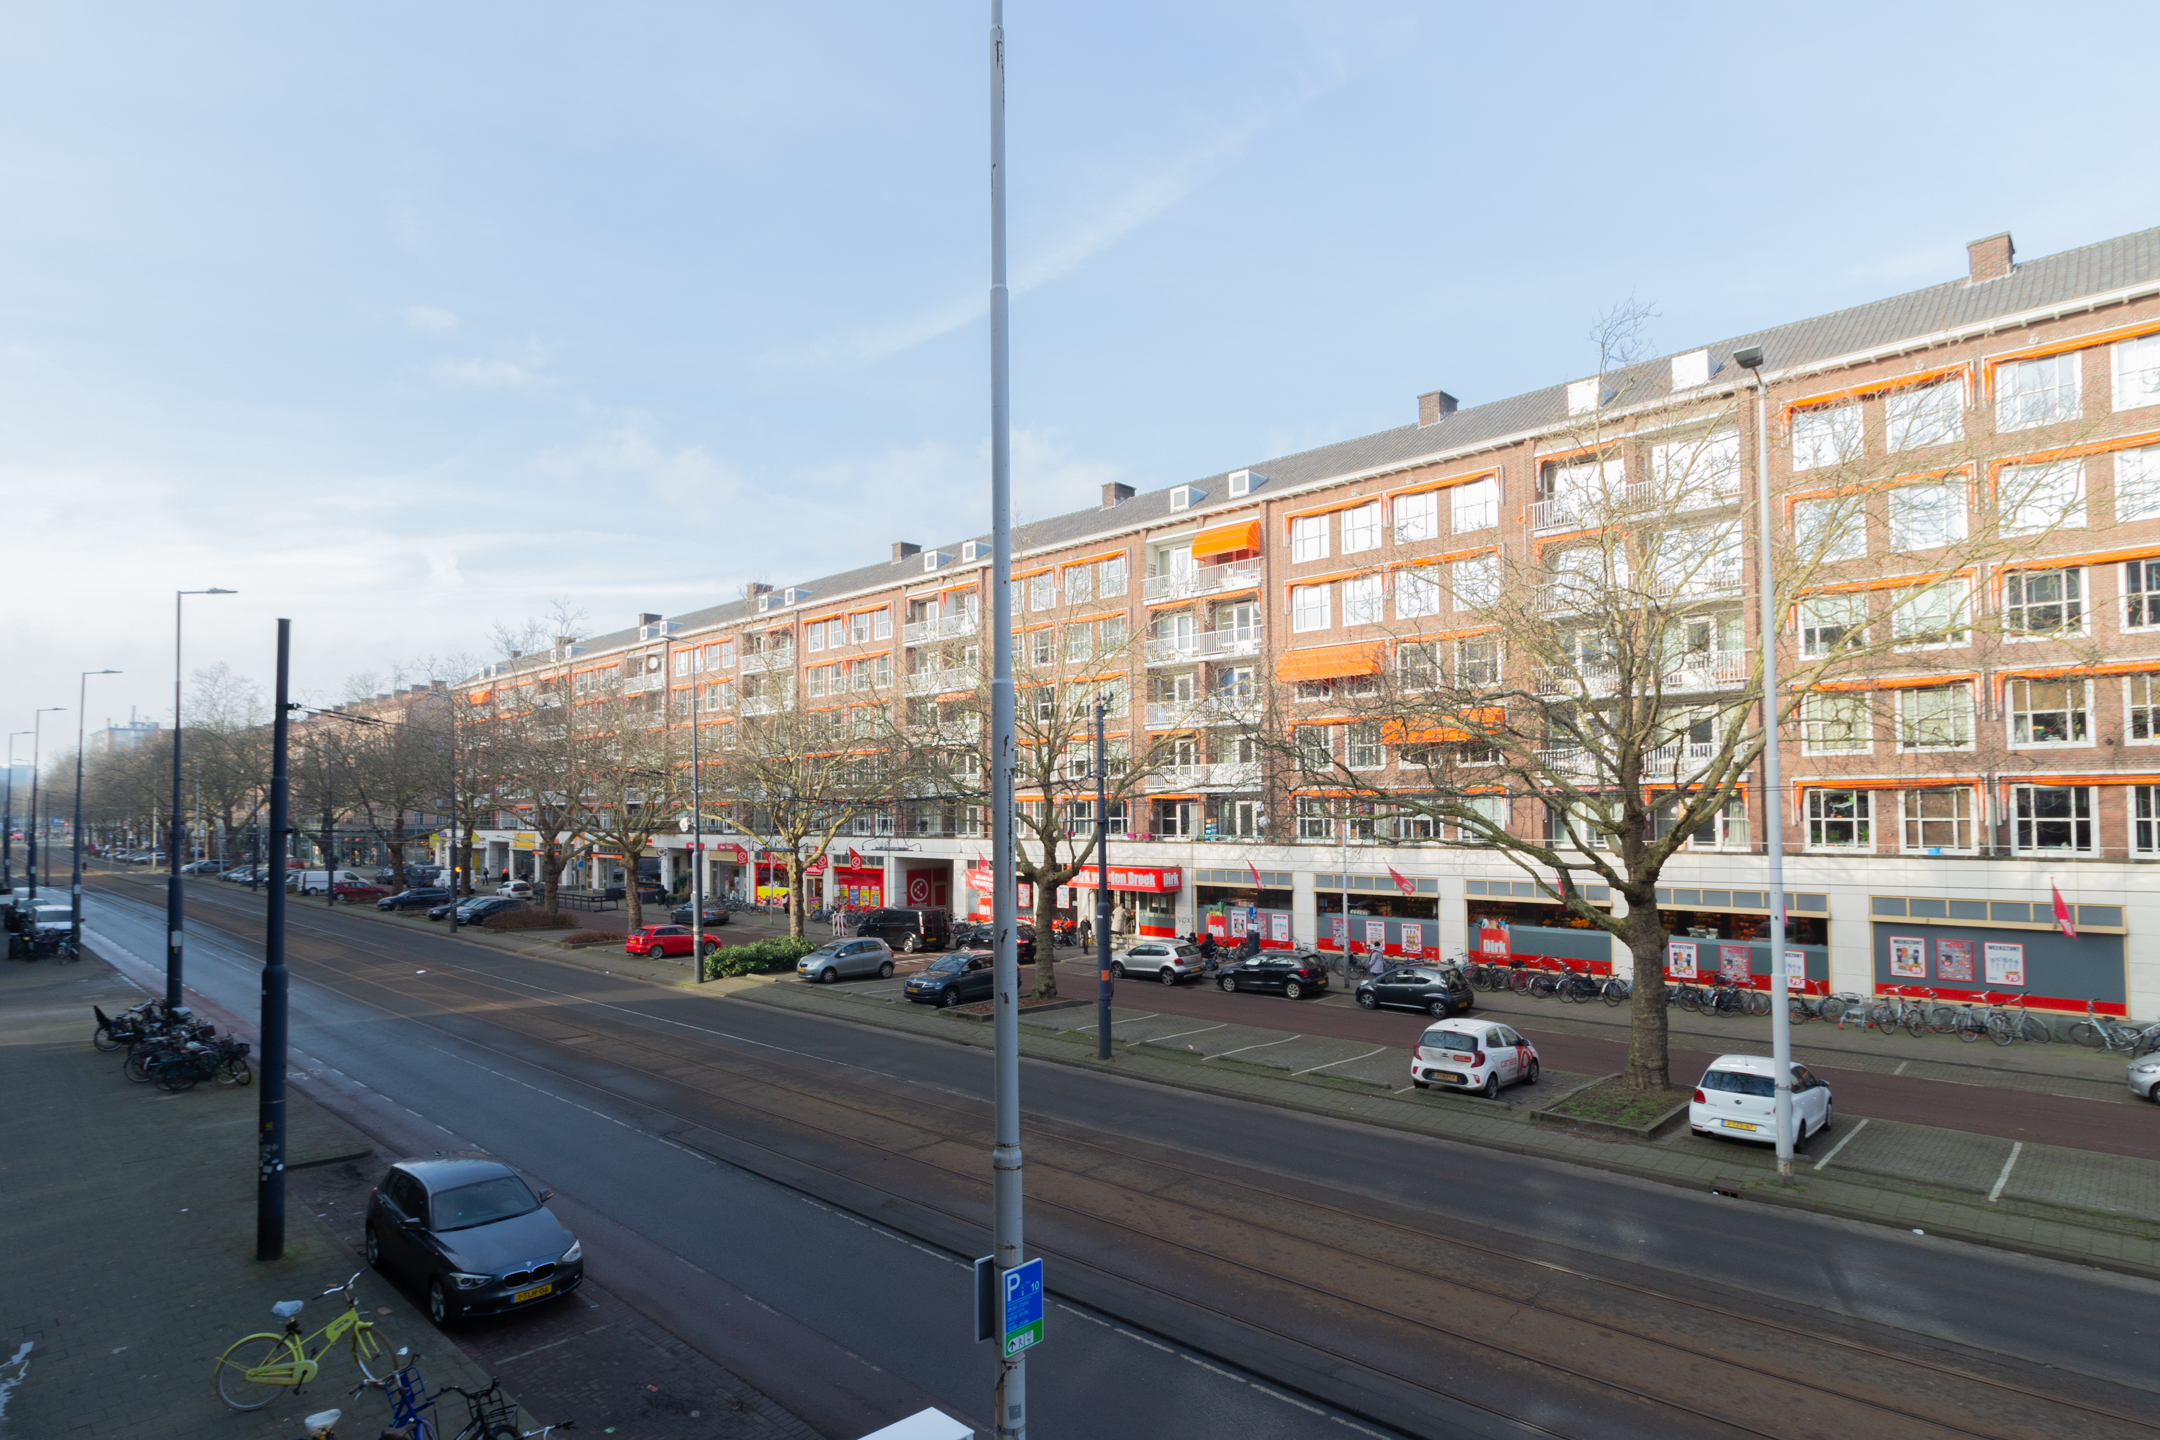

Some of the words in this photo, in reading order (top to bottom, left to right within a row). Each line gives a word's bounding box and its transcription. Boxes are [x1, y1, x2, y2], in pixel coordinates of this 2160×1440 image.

[1108, 871, 1127, 884] den
[1128, 872, 1155, 886] Broek
[1163, 872, 1179, 886] Dirk
[1208, 925, 1225, 937] Dirk
[1483, 940, 1506, 953] Dirk
[1007, 1273, 1020, 1302] P
[1031, 1280, 1040, 1292] 10
[518, 1287, 549, 1300] 1-TLH-06
